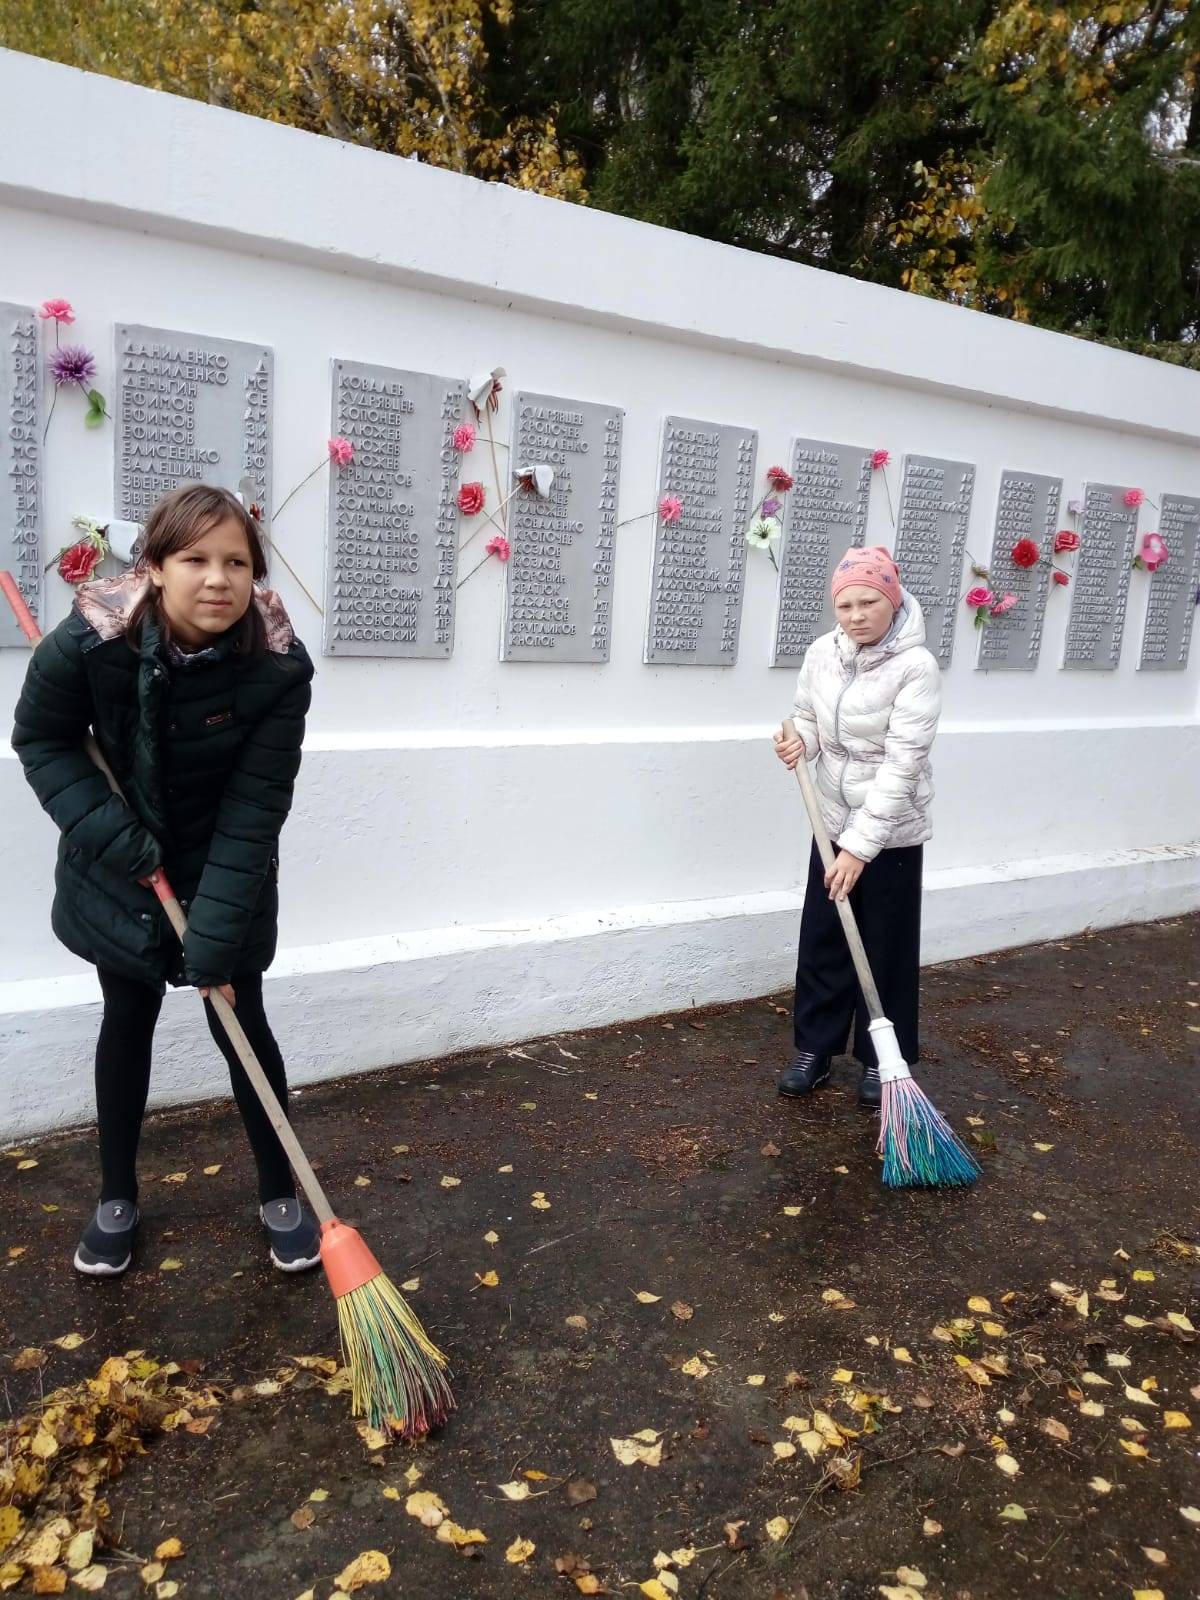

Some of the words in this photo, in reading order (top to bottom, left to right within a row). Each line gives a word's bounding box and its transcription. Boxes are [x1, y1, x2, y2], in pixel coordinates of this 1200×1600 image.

[122, 342, 228, 369] ДАНИЛЕНКО
[122, 358, 228, 385] ДАНИЛЕНКО
[122, 374, 197, 398] ДЕНЬГИН
[339, 376, 404, 396] КОВАЛЕВ
[122, 390, 195, 412] ЕФИМОВ
[339, 392, 415, 413] КУДРЯВЦЕВ
[122, 407, 195, 429] ЕФИМОВ
[121, 424, 194, 445] ЕФИМОВ
[339, 423, 401, 441] КЛЮЖЕВ
[121, 441, 220, 463] ЕЛИСЕЕНКО
[520, 435, 589, 453] КОВАЛЕНКО
[520, 449, 566, 464] КОЗЛОВ
[121, 457, 202, 478] ЗАЛЕШИН
[121, 473, 178, 491] ЗВЕРЕВ
[336, 498, 415, 516] КОЛМЫКОВ
[516, 518, 584, 533] КОВАЛЕНКО
[336, 528, 419, 544] КОВАЛЕНКО
[336, 542, 419, 558] КОВАЛЕНКО
[515, 544, 561, 557] КОЗЛОВ
[335, 556, 418, 572] КОВАЛЕНКО
[514, 557, 560, 570] КОЗЛОВ
[335, 571, 391, 584] ЛЕОНОВ
[334, 585, 422, 600] ЛИХТАРОВИЧ
[334, 599, 417, 614] ЛИСОВСКИЙ
[333, 613, 417, 627] ЛИСОВСКИЙ
[333, 627, 417, 642] ЛИСОВСКИЙ
